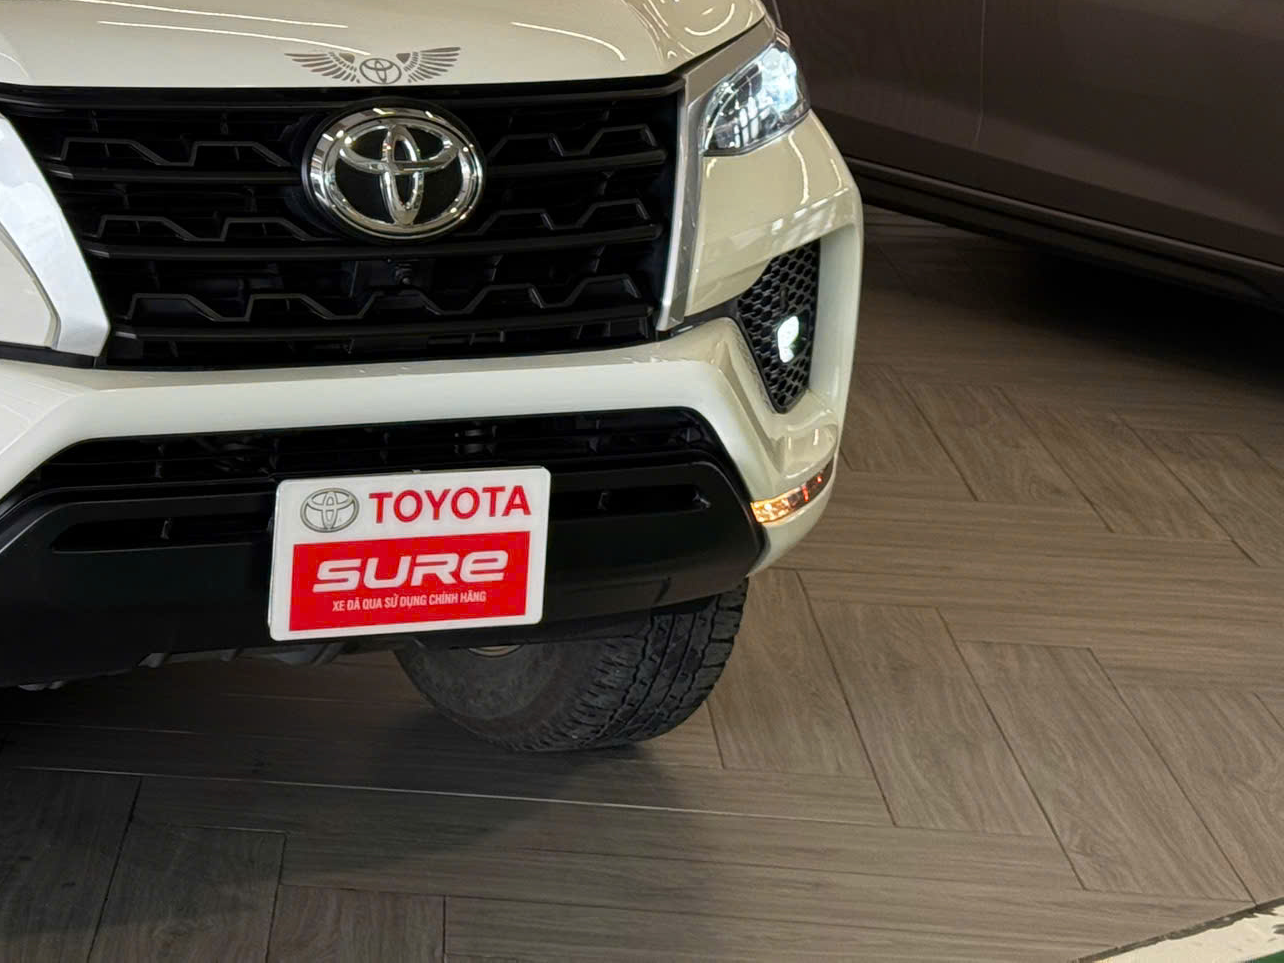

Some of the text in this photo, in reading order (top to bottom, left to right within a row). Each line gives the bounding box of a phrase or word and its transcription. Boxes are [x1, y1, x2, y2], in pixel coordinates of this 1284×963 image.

[369, 485, 531, 523] TOYOTA
[332, 600, 345, 611] XE
[362, 596, 383, 609] QUA
[429, 591, 459, 605] CHÍNH
